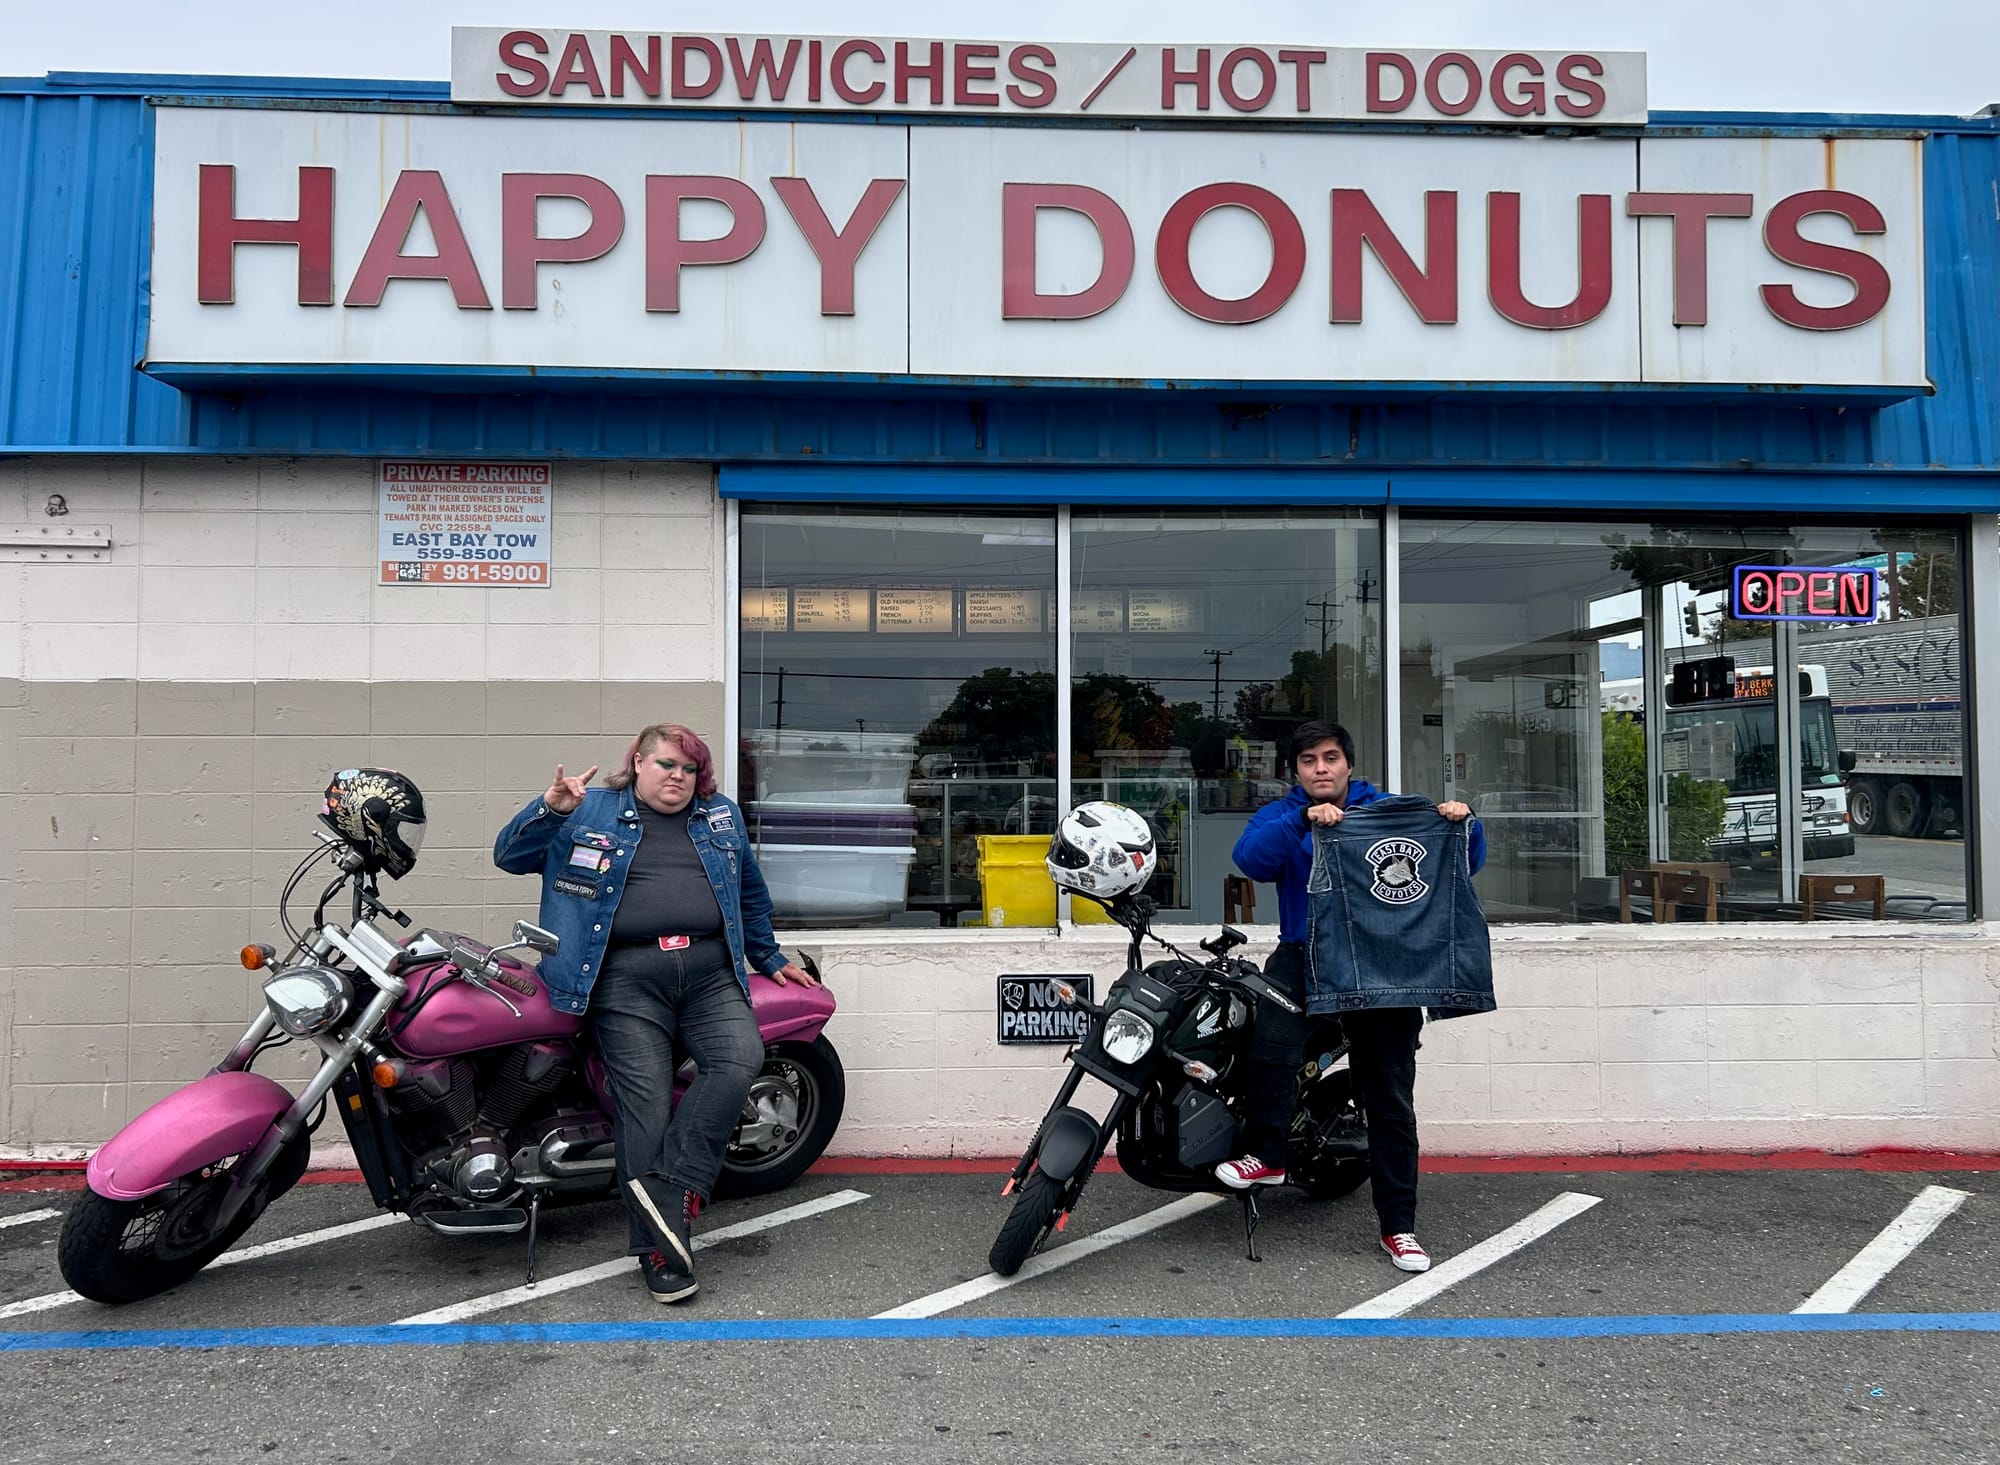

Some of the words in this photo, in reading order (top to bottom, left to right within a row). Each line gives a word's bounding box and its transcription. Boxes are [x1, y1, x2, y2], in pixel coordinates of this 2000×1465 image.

[496, 30, 1058, 109] SANDWICHES
[1081, 47, 1137, 110] /
[1161, 47, 1327, 112] HOT
[1365, 52, 1606, 117] DOGS
[198, 163, 907, 317] HAPPY
[1001, 182, 1891, 331] DONUTS
[386, 465, 461, 481] PRIVATE
[466, 466, 545, 482] PARKING
[390, 484, 406, 492] ALL
[409, 485, 478, 493] UNAUTHORIZED
[506, 486, 528, 494] WILL
[530, 486, 542, 494] BE
[386, 494, 418, 502] TOWED
[420, 494, 432, 502] AT
[434, 494, 460, 502] THEIR
[463, 495, 502, 503] OWNER'S
[505, 496, 545, 504] EXPENSE
[406, 504, 426, 512] PARK
[429, 504, 437, 512] IN
[439, 504, 471, 512] MARKED
[504, 505, 524, 513] ONLY
[422, 514, 442, 522] PARK
[444, 514, 452, 522] IN
[454, 514, 493, 522] ASSIGNED
[526, 515, 546, 523] ONLY
[447, 524, 492, 532] 22658-A
[392, 533, 443, 546] EAST
[450, 534, 488, 546] BAY
[494, 534, 537, 547] TOW
[417, 548, 512, 560] 559-8500
[442, 564, 541, 581] 981-5900
[1741, 571, 1870, 615] OPEN
[1750, 678, 1773, 689] BERK
[1374, 844, 1397, 859] EAST
[1399, 844, 1420, 858] BAY
[1379, 883, 1419, 898] COYOTES
[1029, 983, 1060, 1008] NO
[1003, 1010, 1088, 1036] PARKING
